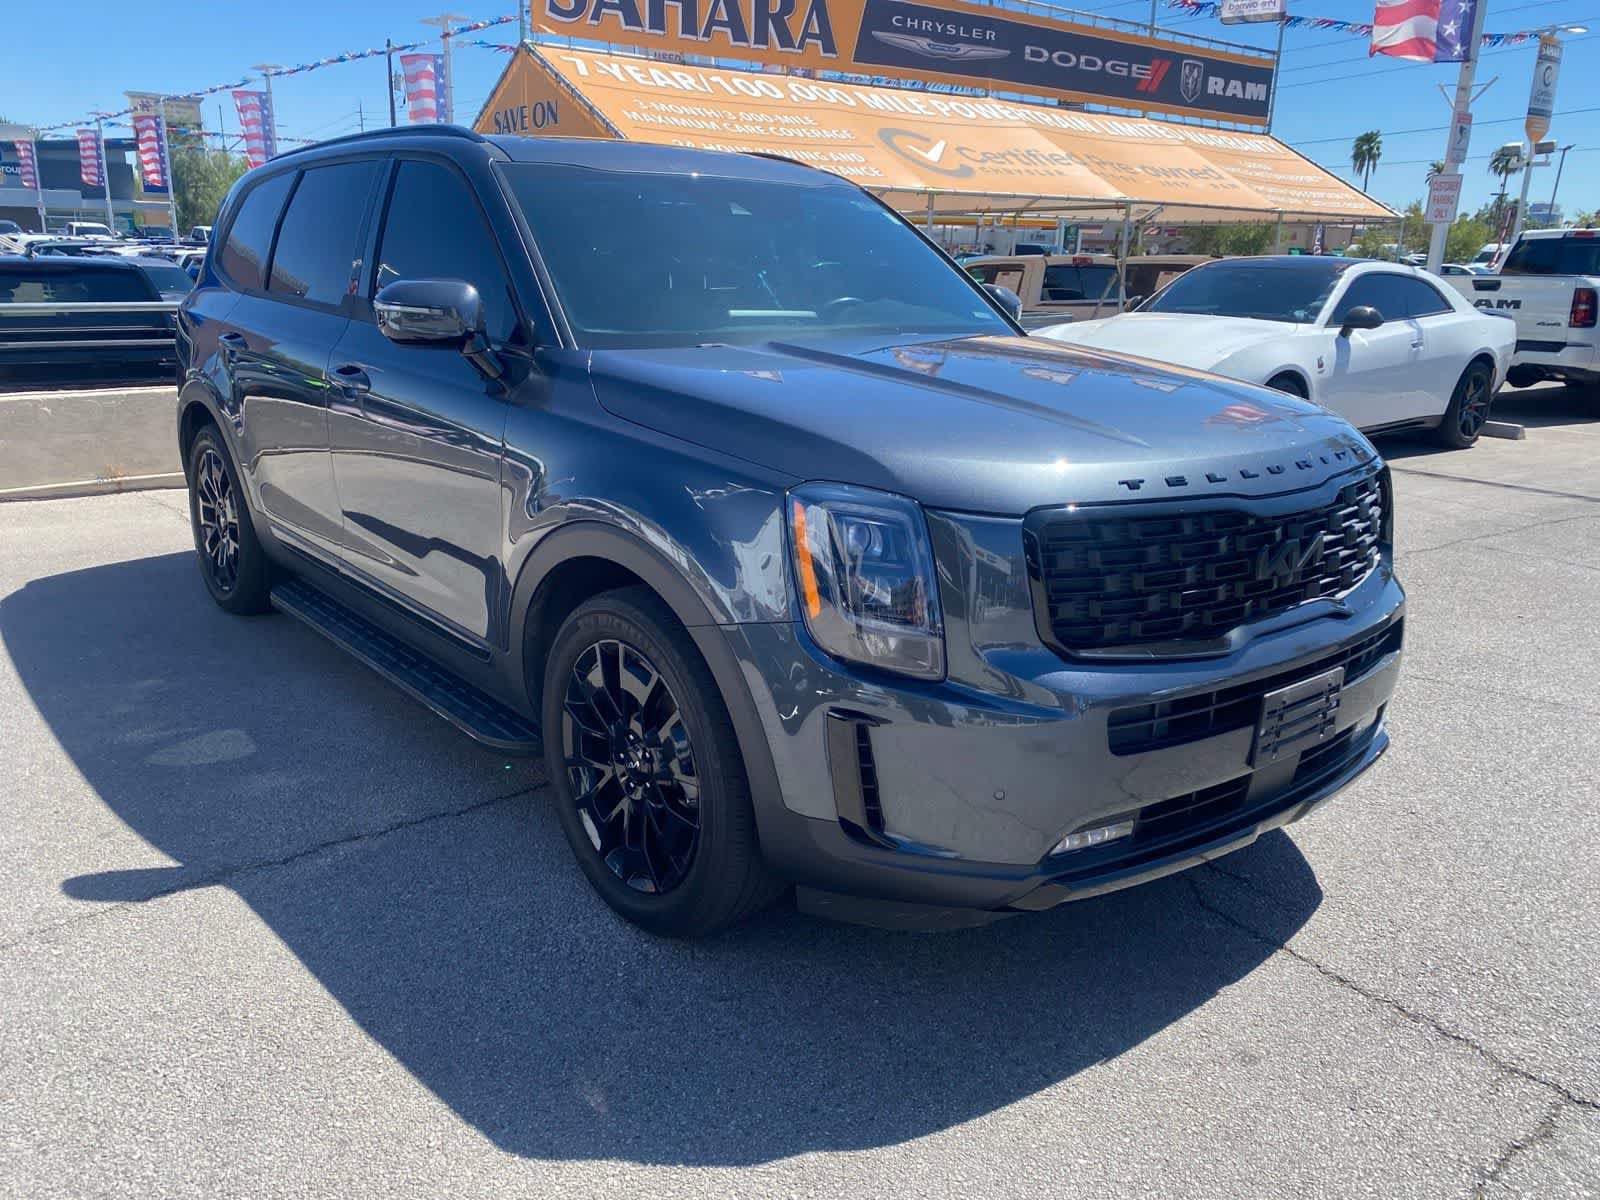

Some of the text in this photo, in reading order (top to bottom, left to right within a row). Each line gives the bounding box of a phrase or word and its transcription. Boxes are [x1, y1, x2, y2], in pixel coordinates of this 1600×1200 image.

[892, 15, 996, 40] CHRYSLER
[1024, 45, 1152, 79] DODGE
[1207, 76, 1268, 101] RAM
[494, 99, 558, 135] SAVE ON
[621, 109, 856, 140] MAXIMUM CARE COVERAGE
[854, 90, 936, 116] MILE
[927, 98, 1101, 134] POWERTRAIN
[1118, 446, 1365, 490] TELLURIDE
